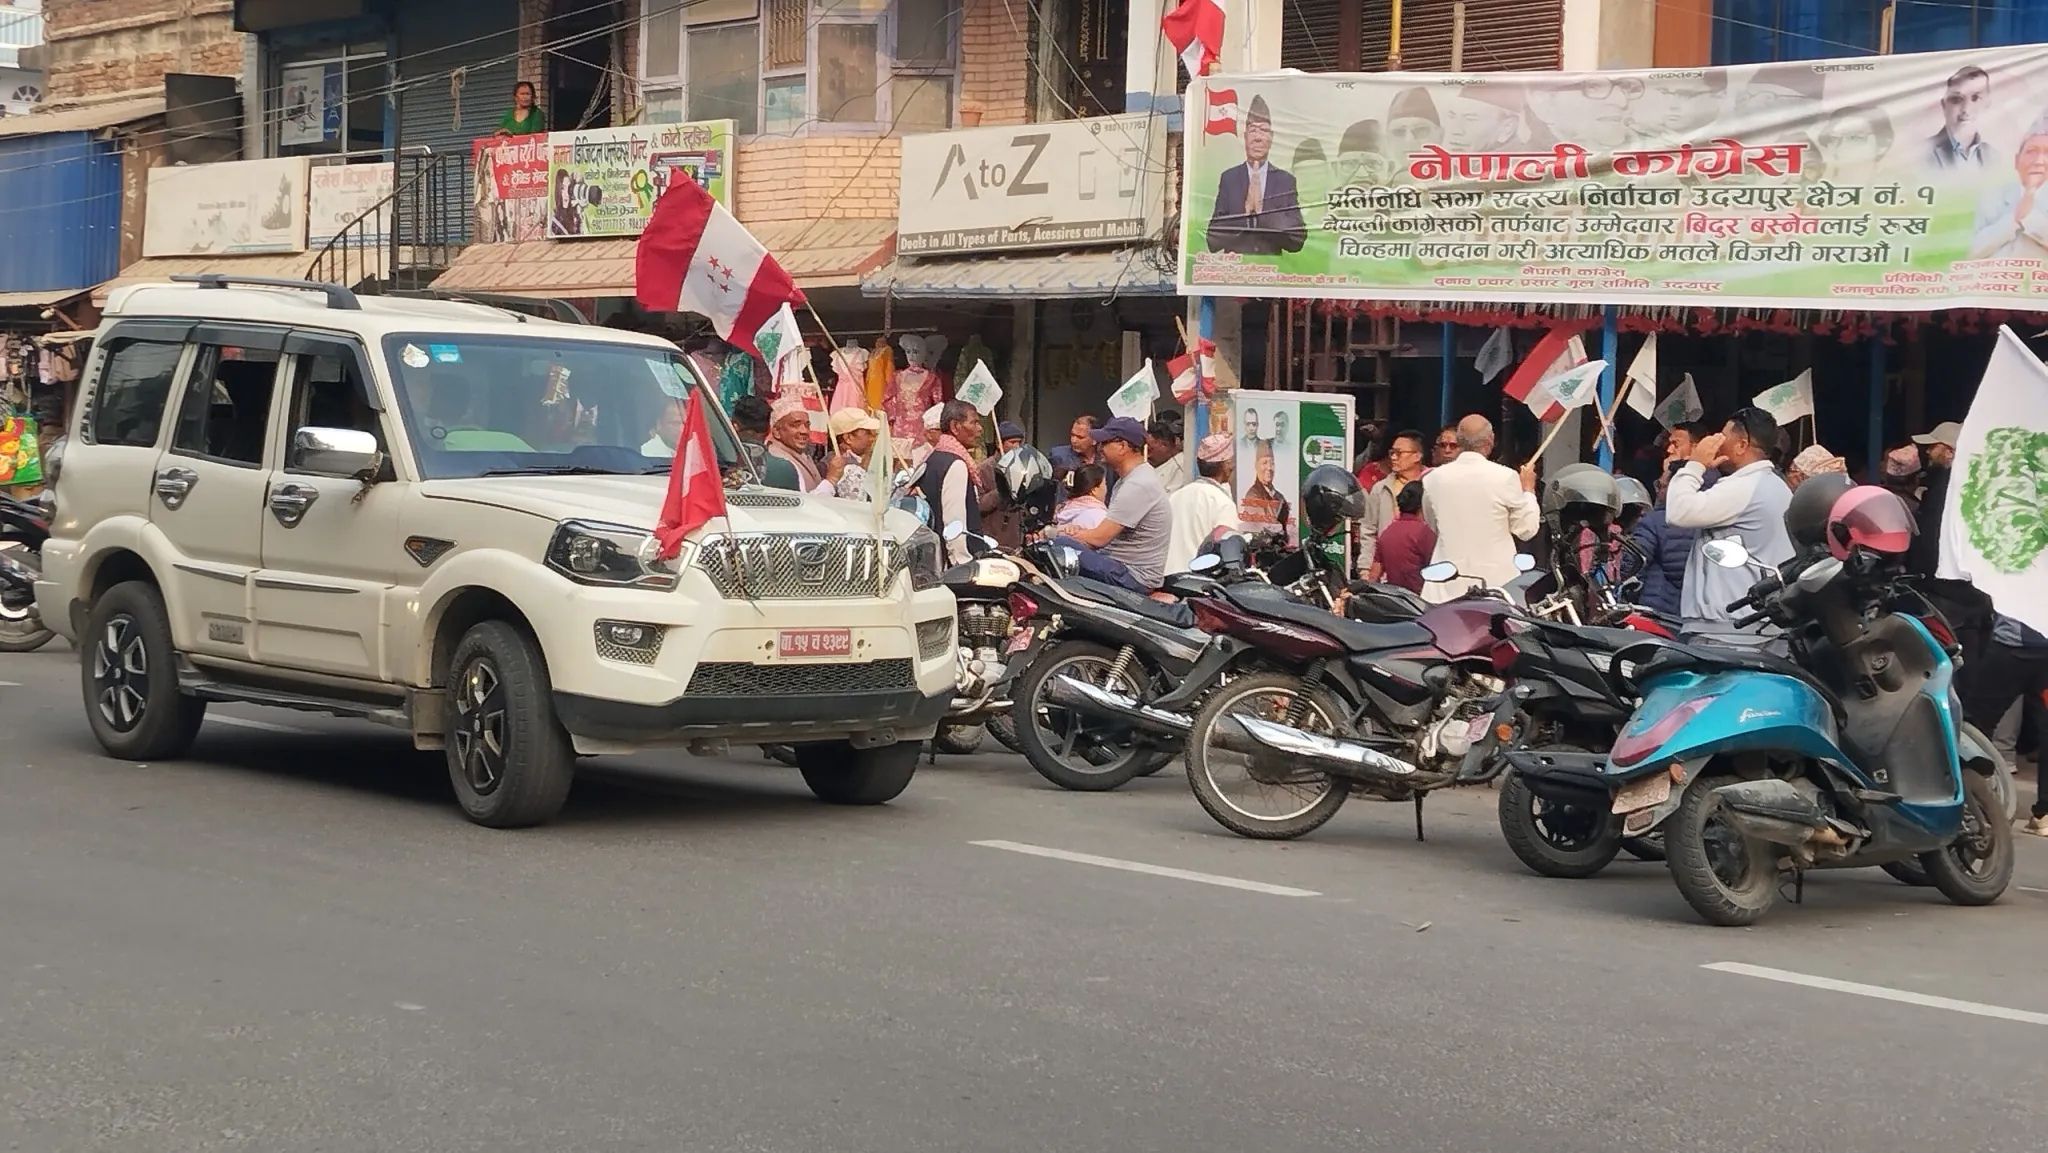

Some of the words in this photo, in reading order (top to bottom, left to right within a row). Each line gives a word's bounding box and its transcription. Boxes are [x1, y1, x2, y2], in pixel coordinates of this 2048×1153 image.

[1812, 64, 1874, 73] समाजवाद
[661, 124, 681, 148] फोटो
[1409, 145, 1592, 182] नेपाली
[1612, 139, 1808, 179] कांग्रेस
[1328, 188, 1421, 210] प्रतिनिधि
[1431, 190, 1484, 208] सभा
[1493, 189, 1568, 208] सदस्य
[1580, 184, 1682, 207] निर्वाचन
[1692, 188, 1799, 212] उदयपुर
[1807, 181, 1864, 208] क्षेत्र
[1917, 185, 1935, 205] १
[900, 236, 928, 251] Deals
[929, 234, 940, 246] in
[941, 231, 956, 246] All
[957, 231, 986, 248] Types
[987, 229, 999, 243] of
[1001, 228, 1031, 244] Parts,
[1083, 222, 1104, 238] and
[1322, 212, 1385, 232] नेपाली
[1392, 213, 1484, 233] कांग्रेसको
[1492, 213, 1567, 233] तर्फबाट
[1575, 214, 1679, 234] उम्मेदवार
[1685, 212, 1743, 239] बिदुर
[1749, 213, 1871, 237] बस्नेतलाई
[1340, 239, 1411, 257] चिन्हमा
[1418, 243, 1490, 259] मतदान
[1498, 240, 1538, 259] गरी
[1546, 240, 1651, 260] अत्याधिक
[1659, 241, 1720, 261] मतले
[1728, 240, 1803, 262] विजयी
[1522, 265, 1571, 277] नेपाली
[1577, 267, 1626, 278] कांग्रेस
[1434, 278, 1472, 287] चुनाव
[1477, 278, 1513, 287] प्रचार
[1520, 279, 1557, 288] प्रसार
[1601, 278, 1650, 289] समिति
[1660, 281, 1722, 292] उदयपुर
